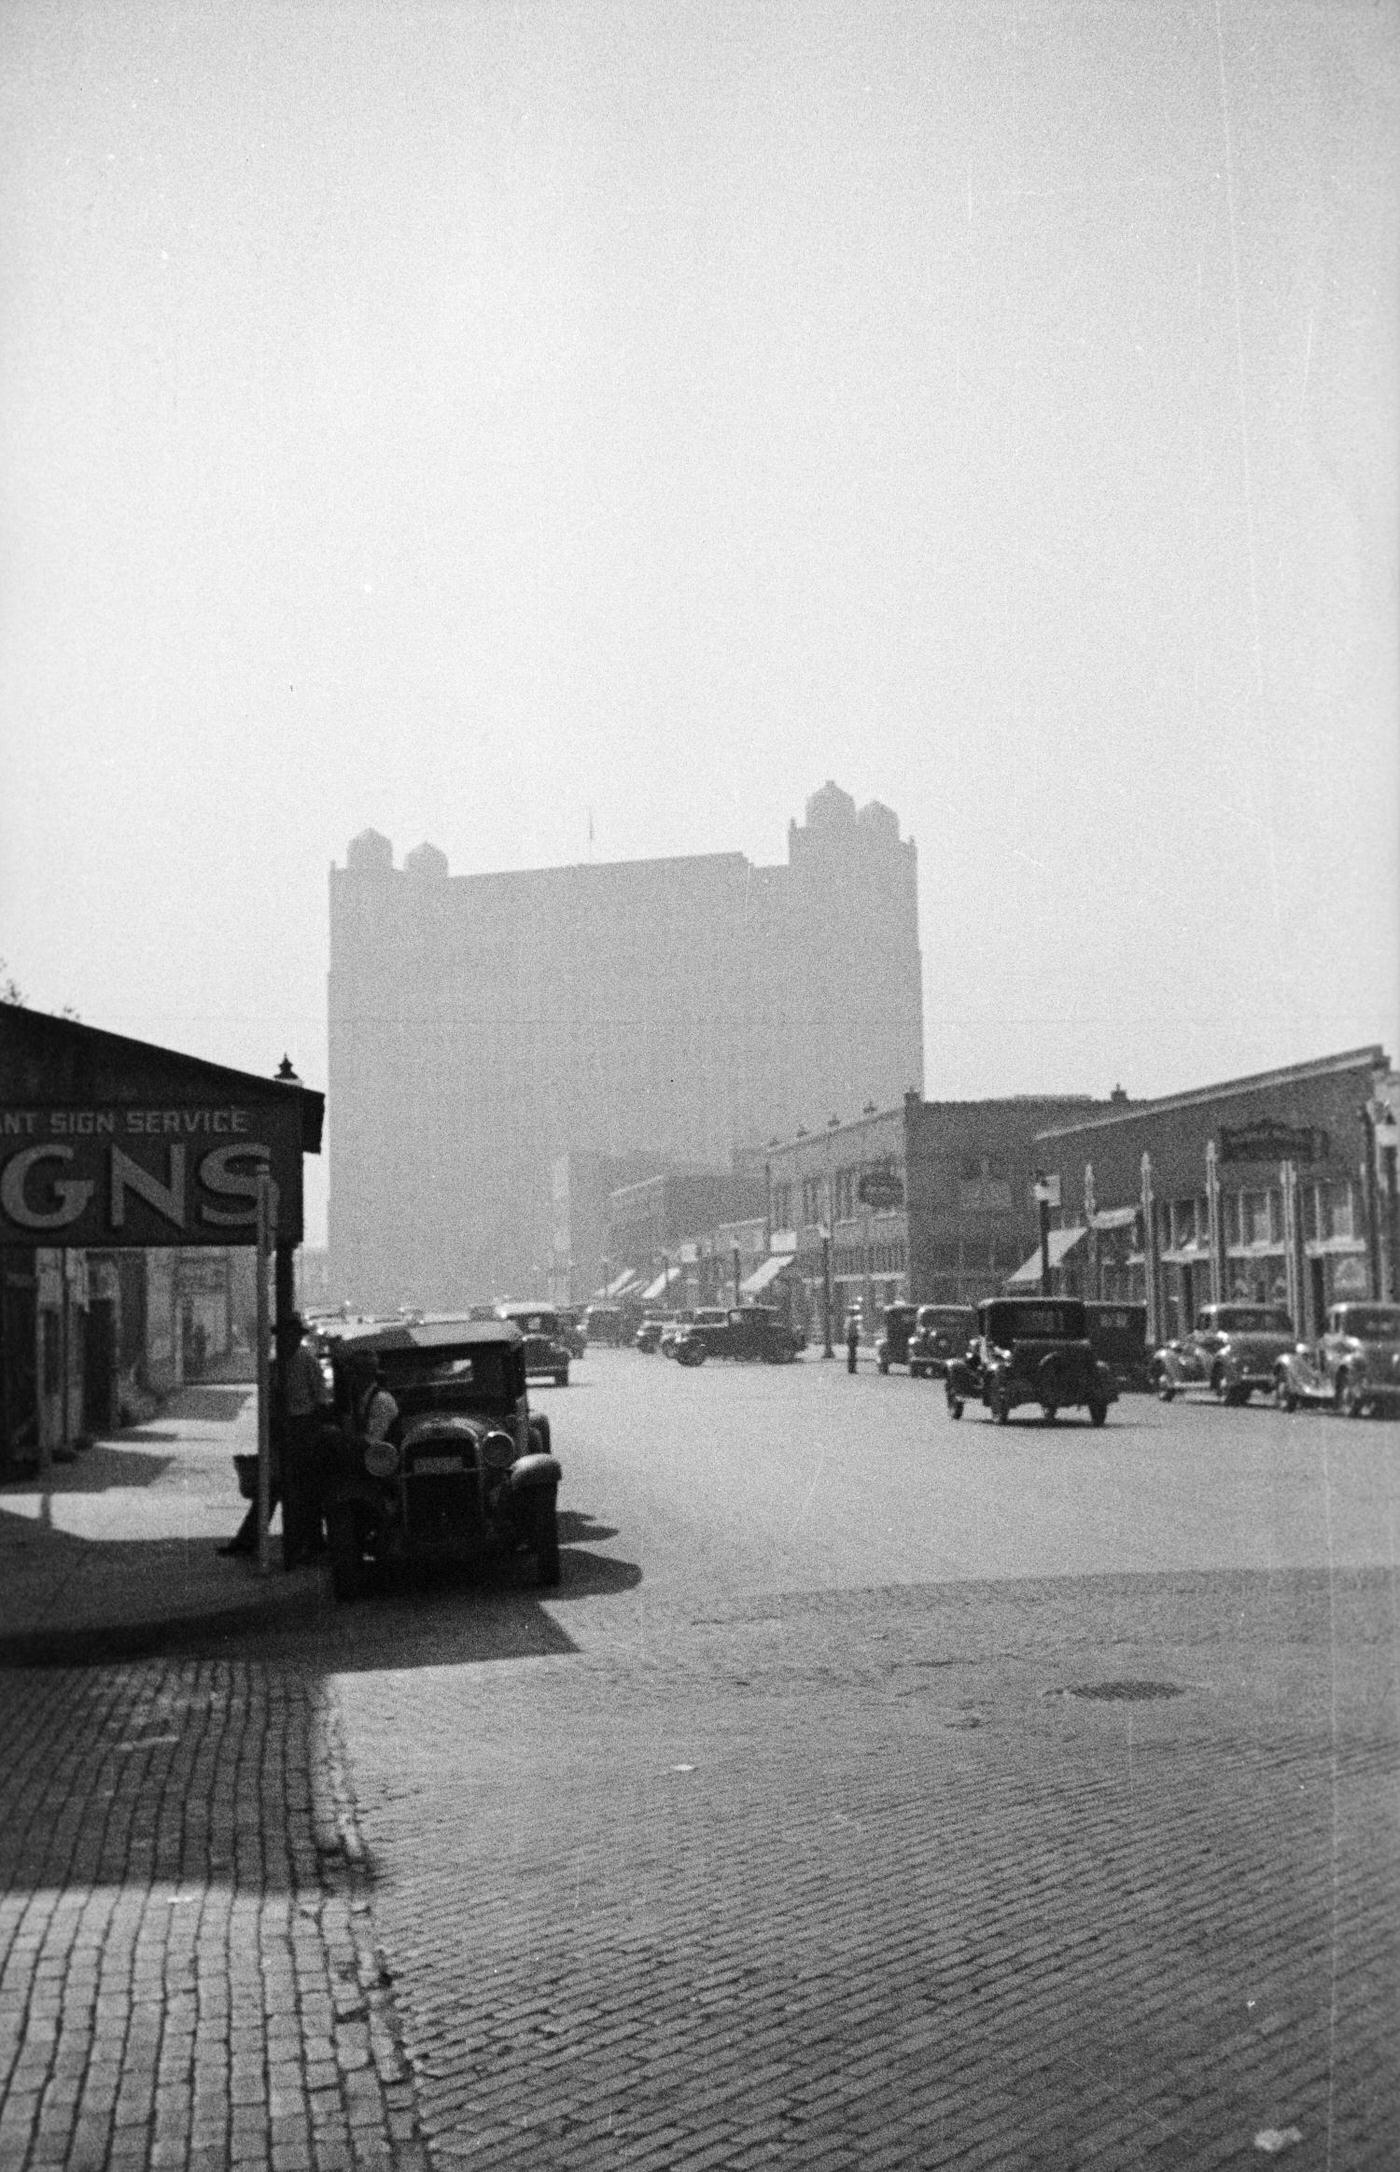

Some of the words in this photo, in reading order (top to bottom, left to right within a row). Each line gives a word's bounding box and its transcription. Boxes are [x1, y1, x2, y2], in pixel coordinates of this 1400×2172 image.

[0, 1112, 37, 1134] NT
[51, 1112, 114, 1134] SIGN
[127, 1110, 249, 1133] SERVICE
